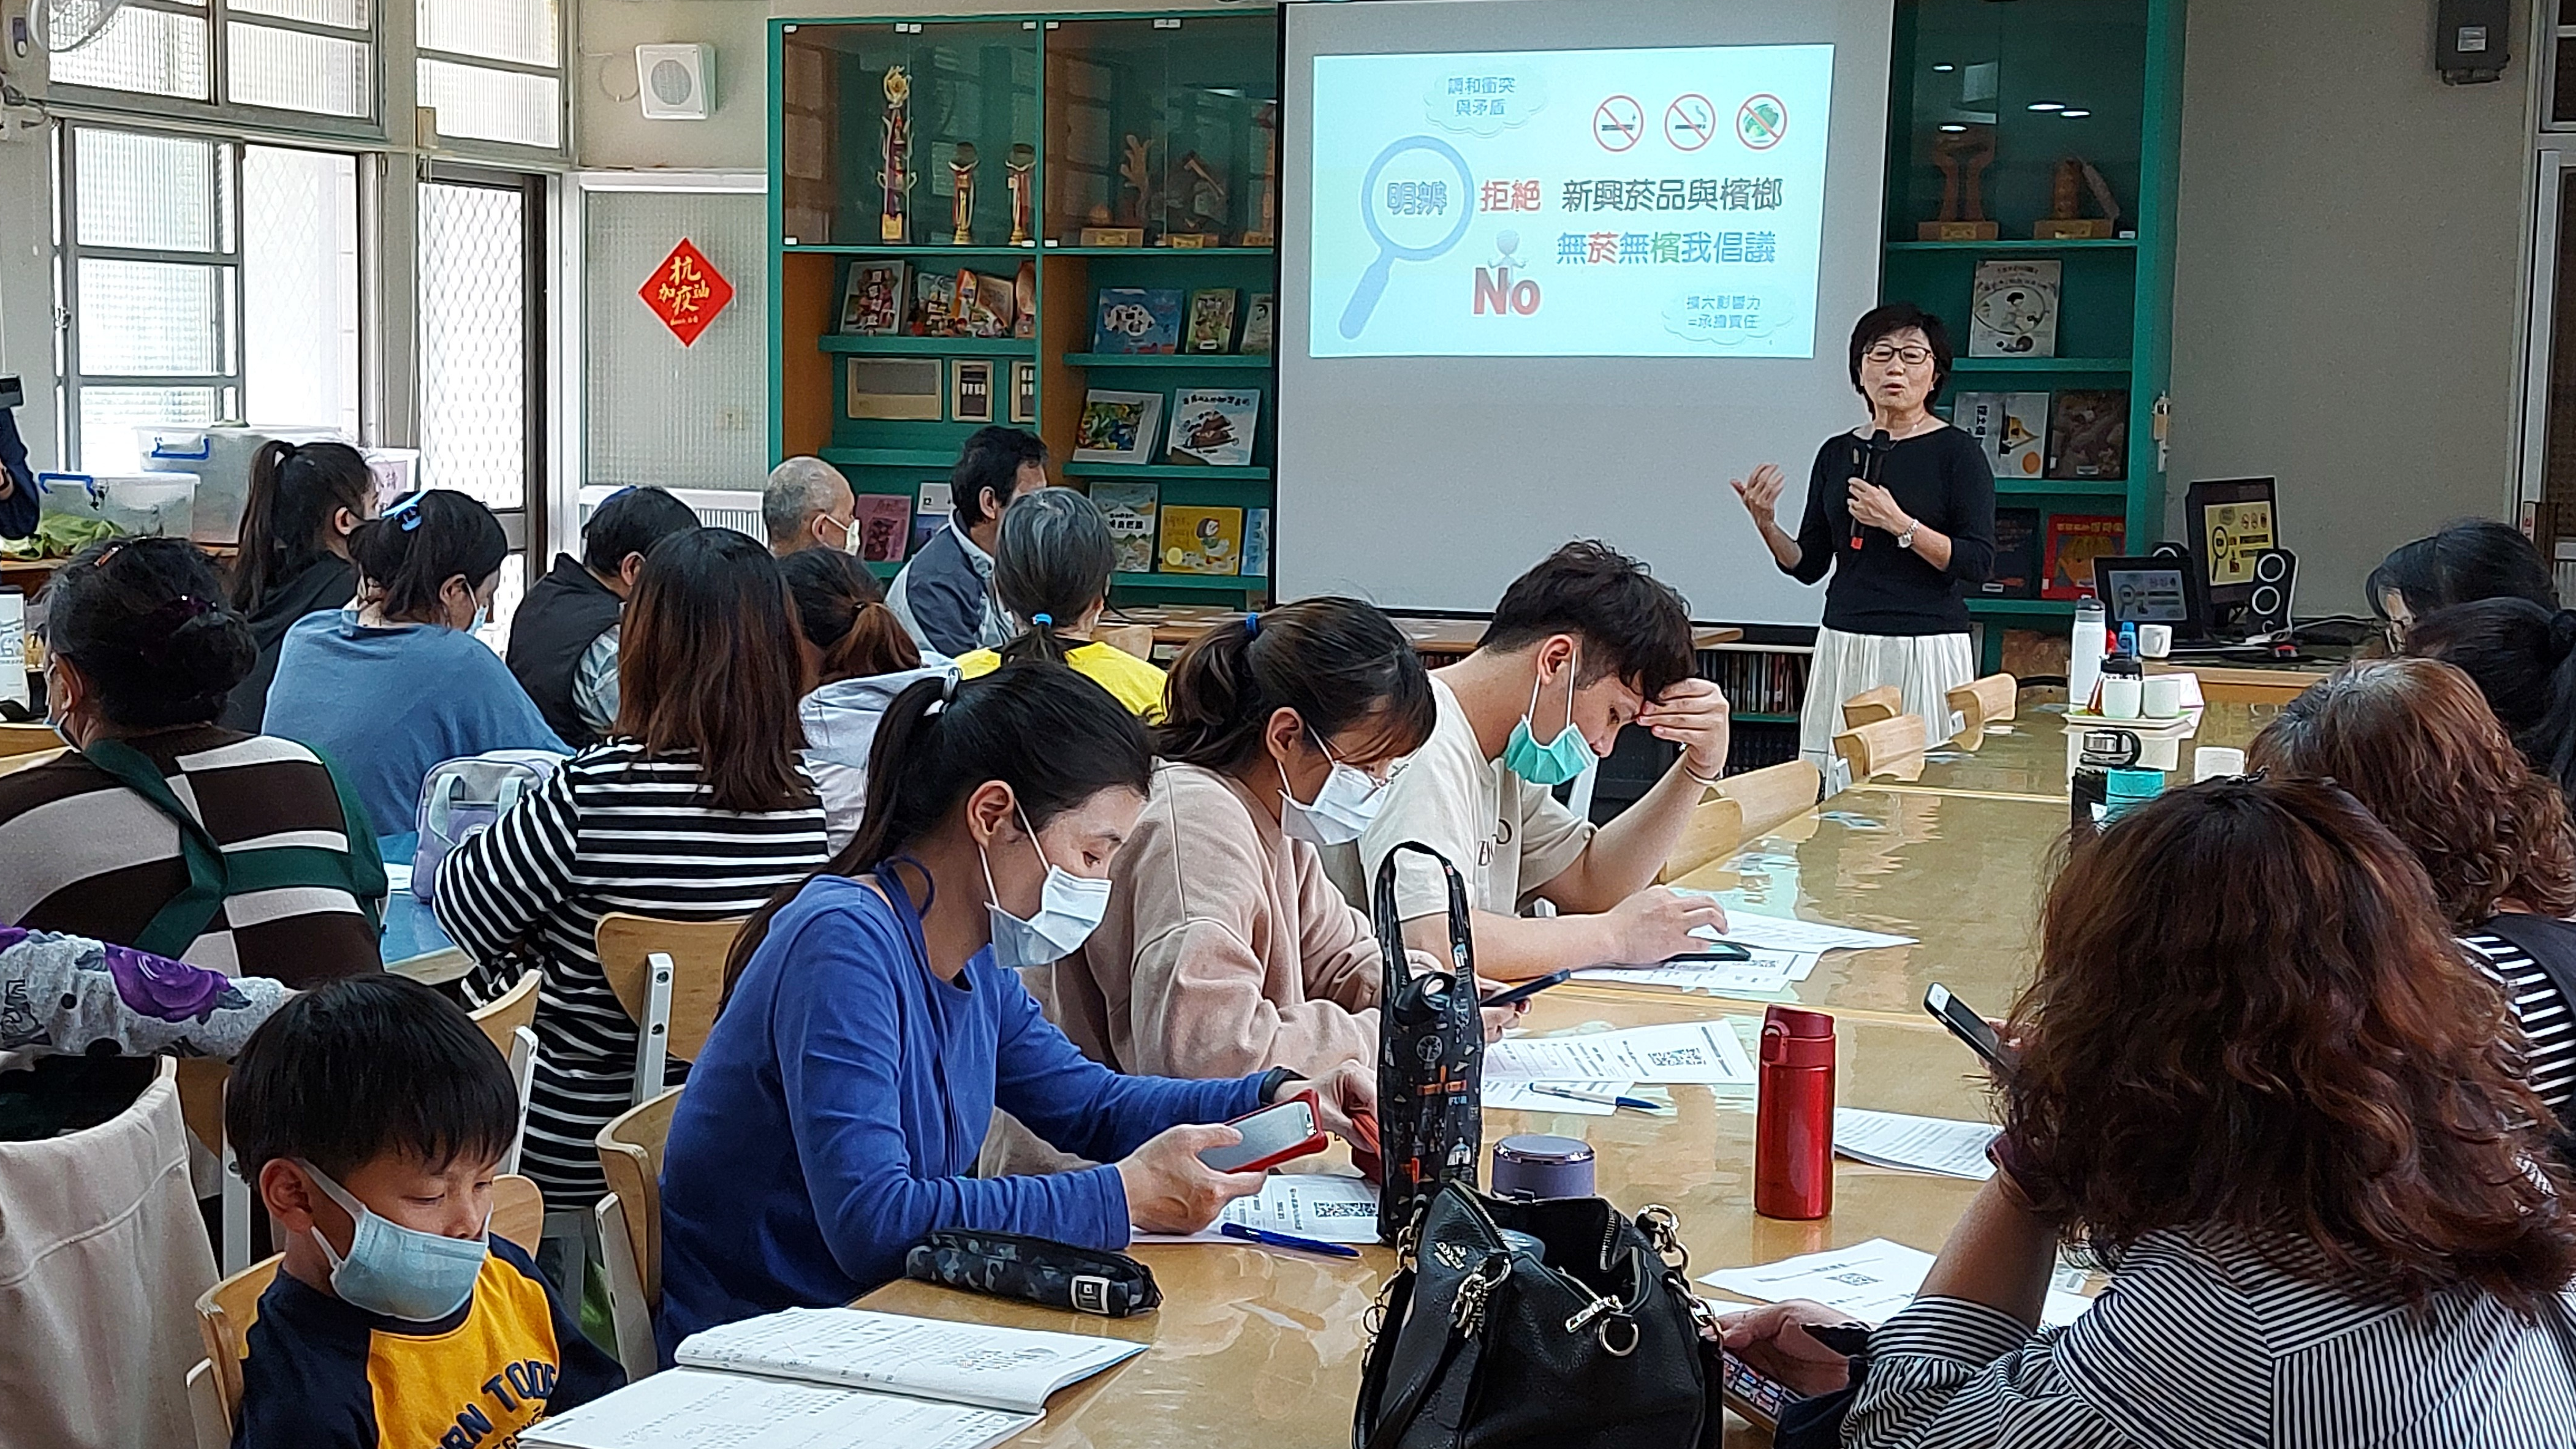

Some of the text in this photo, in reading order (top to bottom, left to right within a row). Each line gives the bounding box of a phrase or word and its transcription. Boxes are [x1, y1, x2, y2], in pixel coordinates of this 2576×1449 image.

[1387, 181, 1447, 215] 明辨
[1562, 178, 1784, 213] 新興菸品與檳榔
[1556, 231, 1776, 265] 無菸無檳我倡議
[1474, 267, 1540, 316] No
